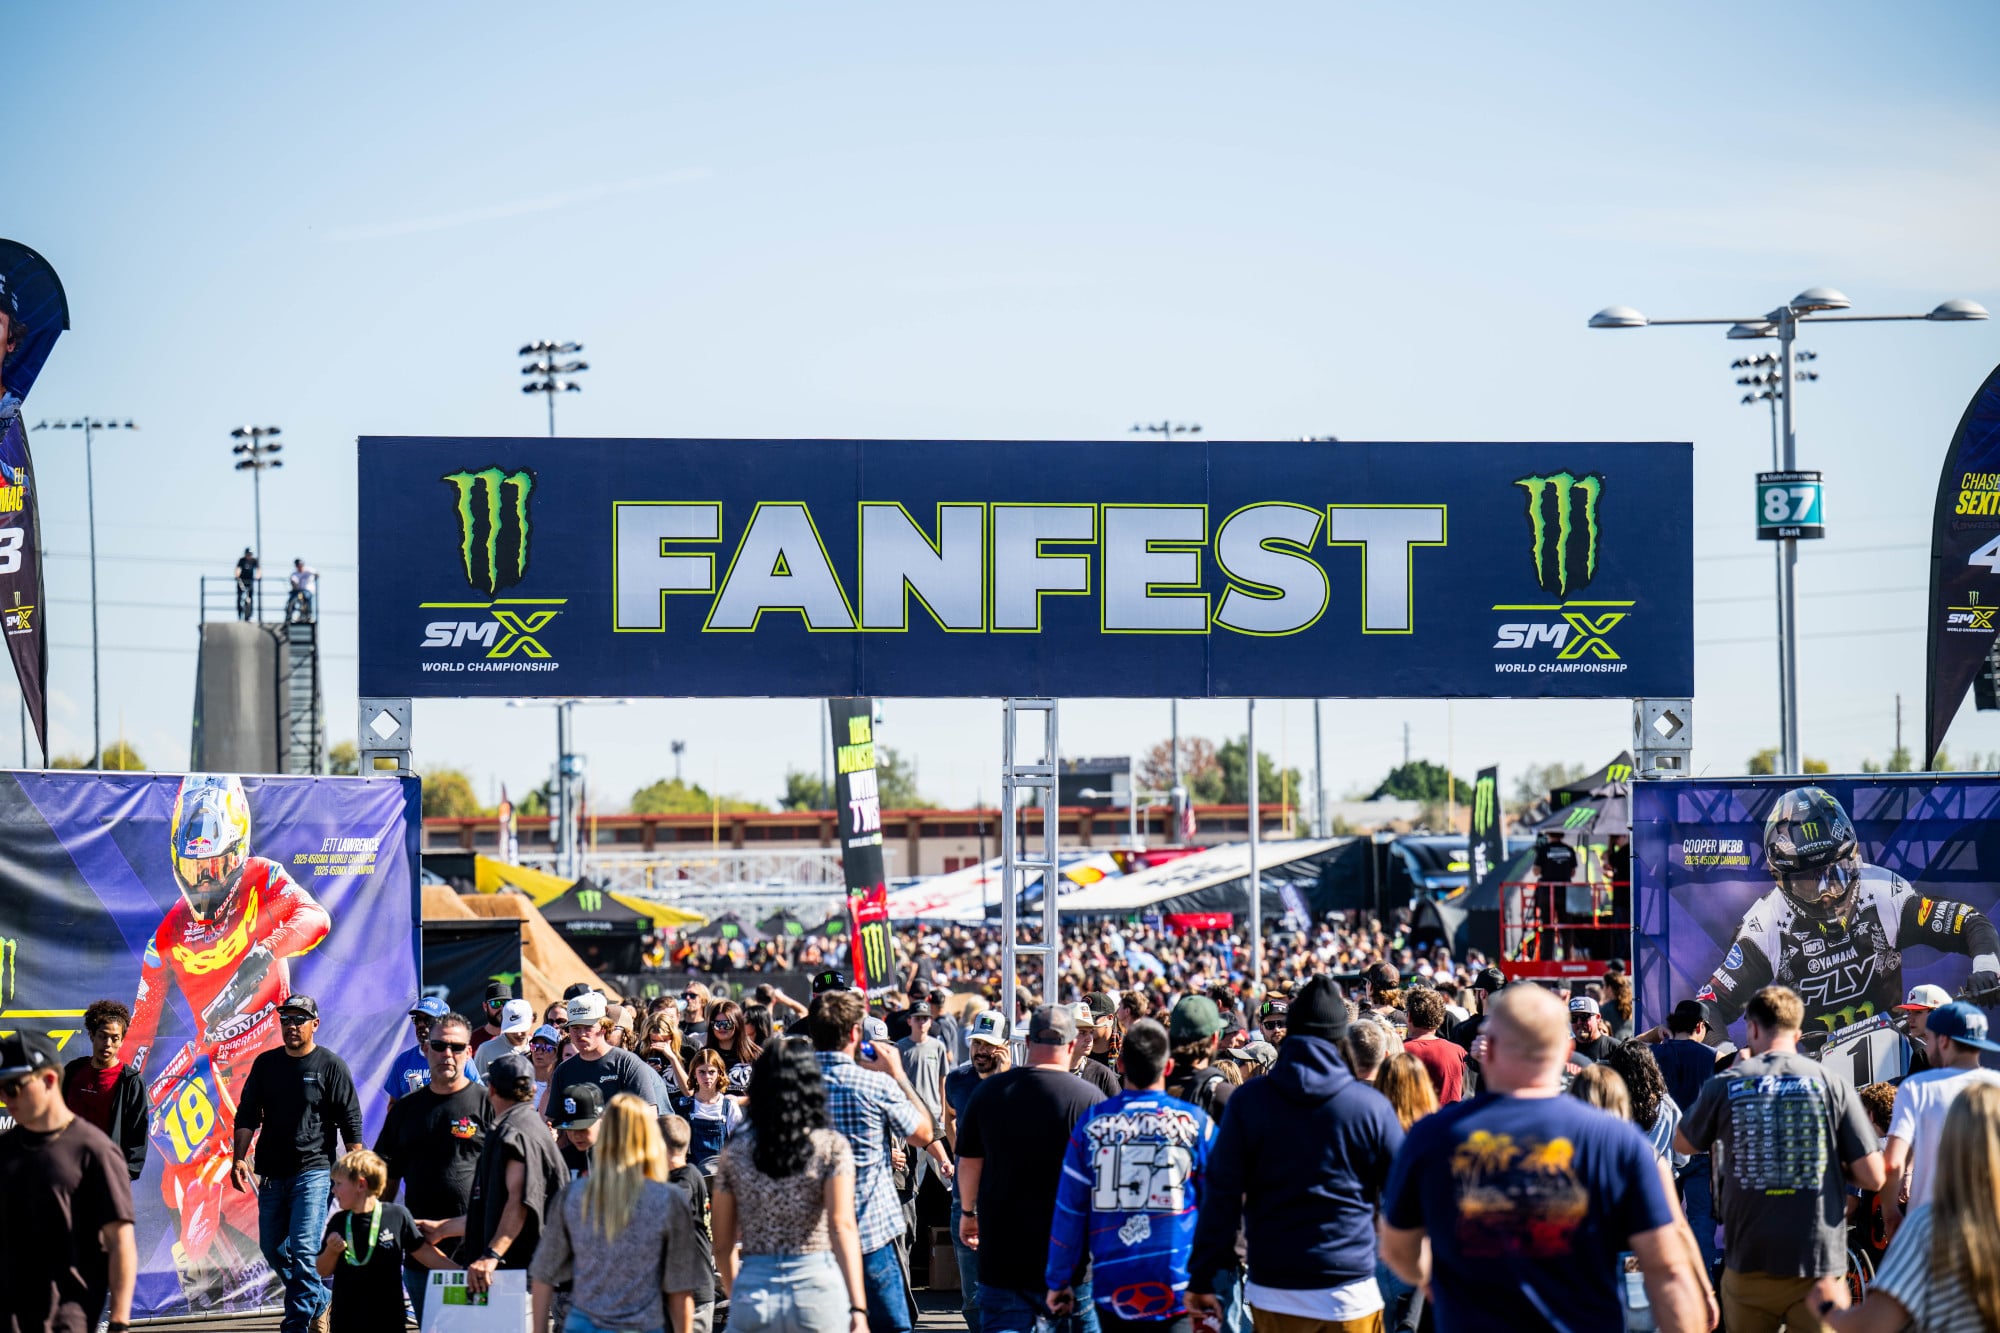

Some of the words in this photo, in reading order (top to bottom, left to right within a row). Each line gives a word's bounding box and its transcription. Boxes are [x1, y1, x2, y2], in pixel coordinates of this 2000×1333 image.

[14, 467, 24, 484] ELI
[1764, 487, 1816, 522] 87
[1779, 527, 1801, 537] East
[1967, 535, 2000, 574] 4
[612, 500, 1448, 637] FANFEST
[1947, 611, 1996, 629] SMX
[419, 611, 558, 658] SMX
[1492, 613, 1627, 659] SMX
[421, 662, 465, 672] WORLD
[467, 662, 559, 672] CHAMPIONSHIP
[1495, 663, 1536, 673] WORLD
[1538, 663, 1628, 673] CHAMPIONSHIP
[320, 838, 338, 852] JETT
[337, 838, 380, 852] LAWRENCE
[1682, 839, 1717, 854] COOPER
[1718, 839, 1744, 854] WEBB
[1797, 840, 1833, 853] MONSTER
[293, 854, 309, 864] 2025
[329, 854, 348, 864] WORLD
[1684, 856, 1699, 865] 2025
[1720, 856, 1751, 865] CHAMPION
[313, 865, 329, 875] 2025
[1804, 940, 1825, 955] 100%
[1819, 947, 1859, 970] YAMAHA
[1800, 952, 1879, 1006] FLY
[211, 1001, 277, 1042] HONDA
[1846, 1034, 1874, 1090] 1
[164, 1076, 216, 1163] 18
[1091, 1142, 1193, 1213] 152
